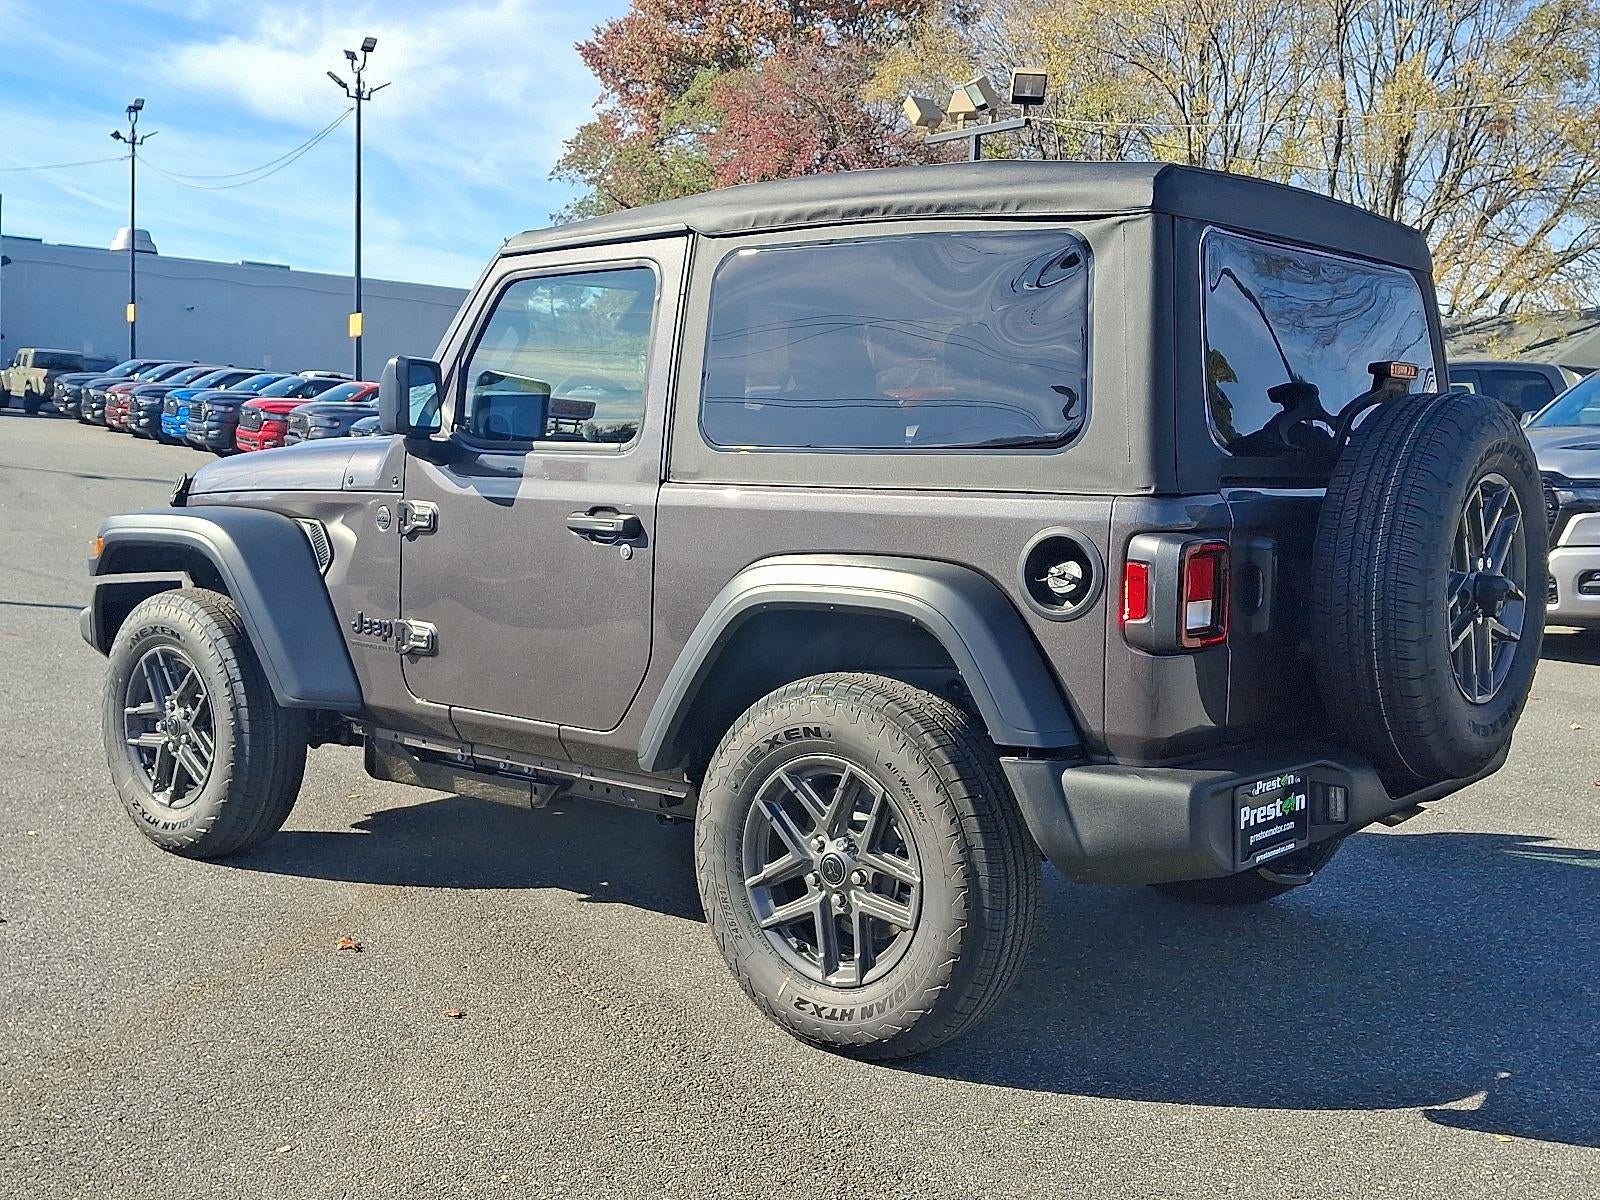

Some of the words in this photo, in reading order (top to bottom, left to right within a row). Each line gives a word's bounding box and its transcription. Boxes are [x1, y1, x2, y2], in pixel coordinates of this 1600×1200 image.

[129, 625, 182, 650] NEXEN
[351, 611, 392, 642] Jeep
[733, 727, 822, 784] NEXEN
[884, 762, 928, 824] All-Weather
[1254, 773, 1294, 795] Preston
[131, 798, 161, 828] HTX2
[1240, 792, 1306, 830] Preston
[1249, 821, 1295, 846] prestonmotor.com
[793, 996, 856, 1022] HTX2
